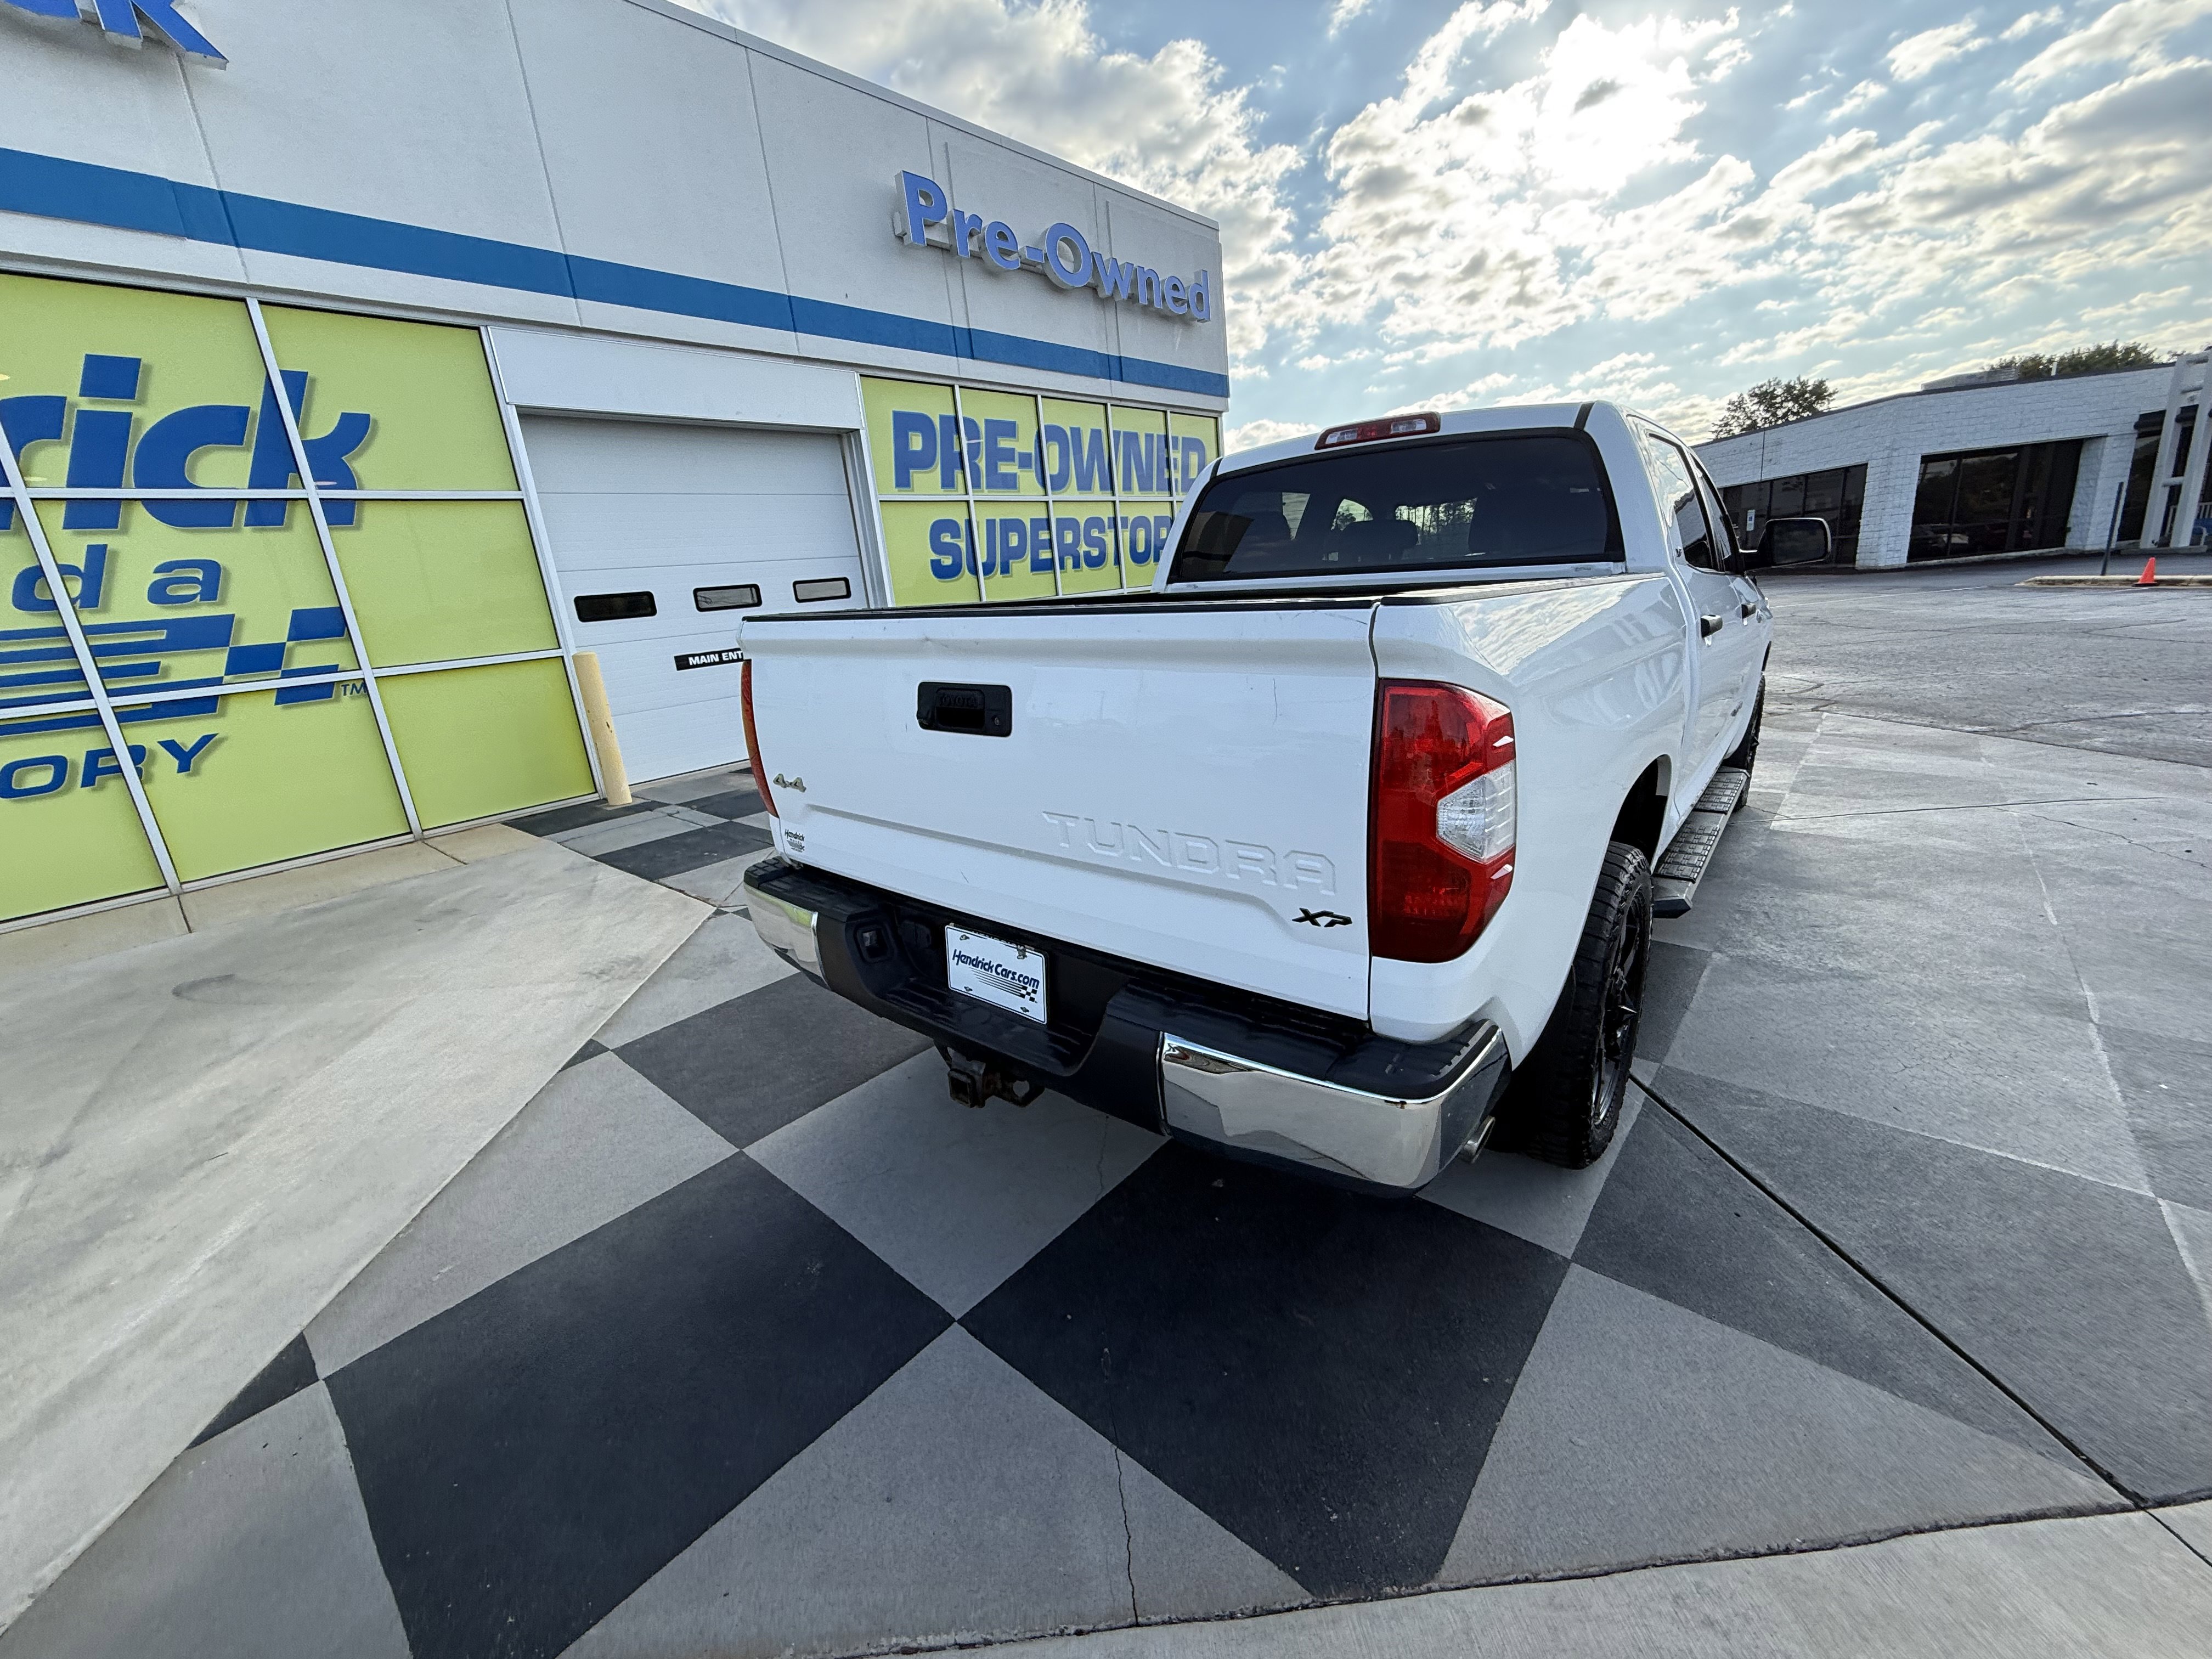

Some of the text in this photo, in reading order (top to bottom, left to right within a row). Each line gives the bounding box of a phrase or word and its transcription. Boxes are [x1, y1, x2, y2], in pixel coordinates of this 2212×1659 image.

[898, 170, 1211, 322] Pre-Owned
[892, 410, 1206, 494] PRE-OWNED
[688, 653, 719, 665] MAIN
[785, 828, 805, 842] Hendrick
[1042, 810, 1336, 896] TUNDRA
